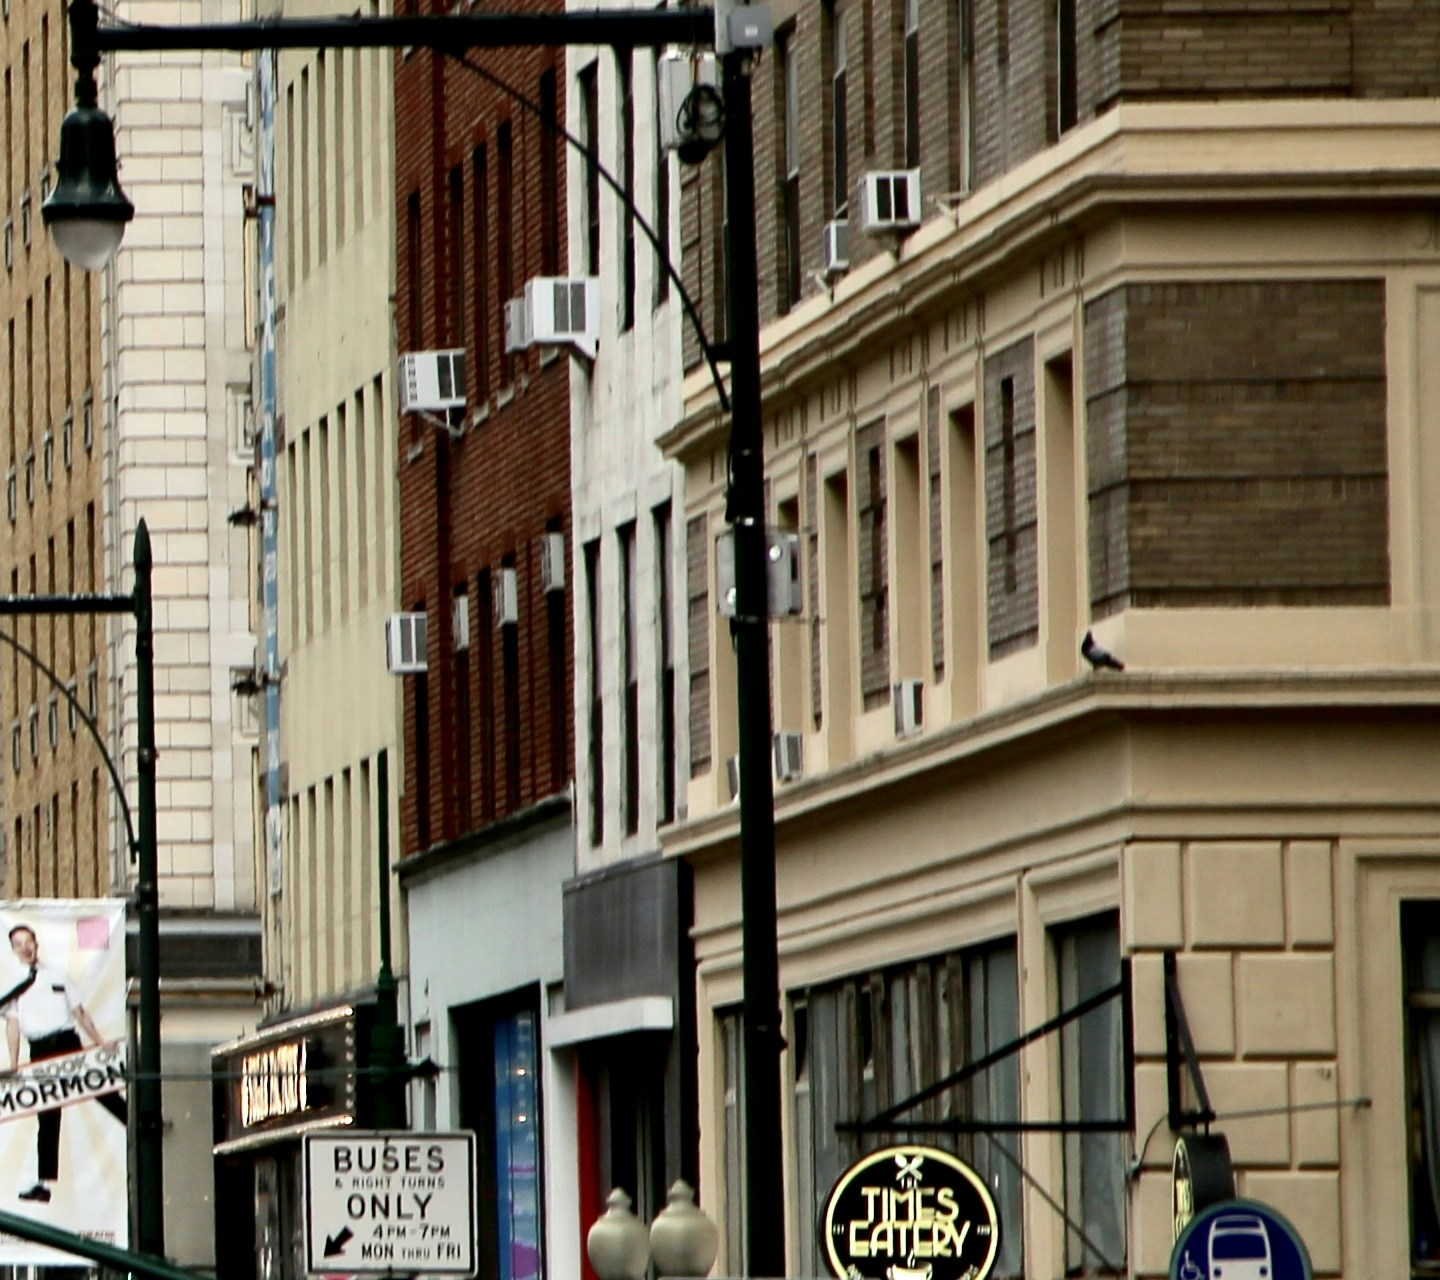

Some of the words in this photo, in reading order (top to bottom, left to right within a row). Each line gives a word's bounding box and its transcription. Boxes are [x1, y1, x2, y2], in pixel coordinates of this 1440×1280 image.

[333, 1146, 445, 1173] BUSES
[352, 1177, 392, 1189] RIGHT
[401, 1177, 445, 1189] TURNS
[347, 1194, 433, 1220] ONLY
[861, 1187, 959, 1223] TIMES
[361, 1243, 394, 1260] MON
[402, 1247, 430, 1259] THRU
[437, 1243, 461, 1260] FRI
[849, 1221, 971, 1258] EATERY
